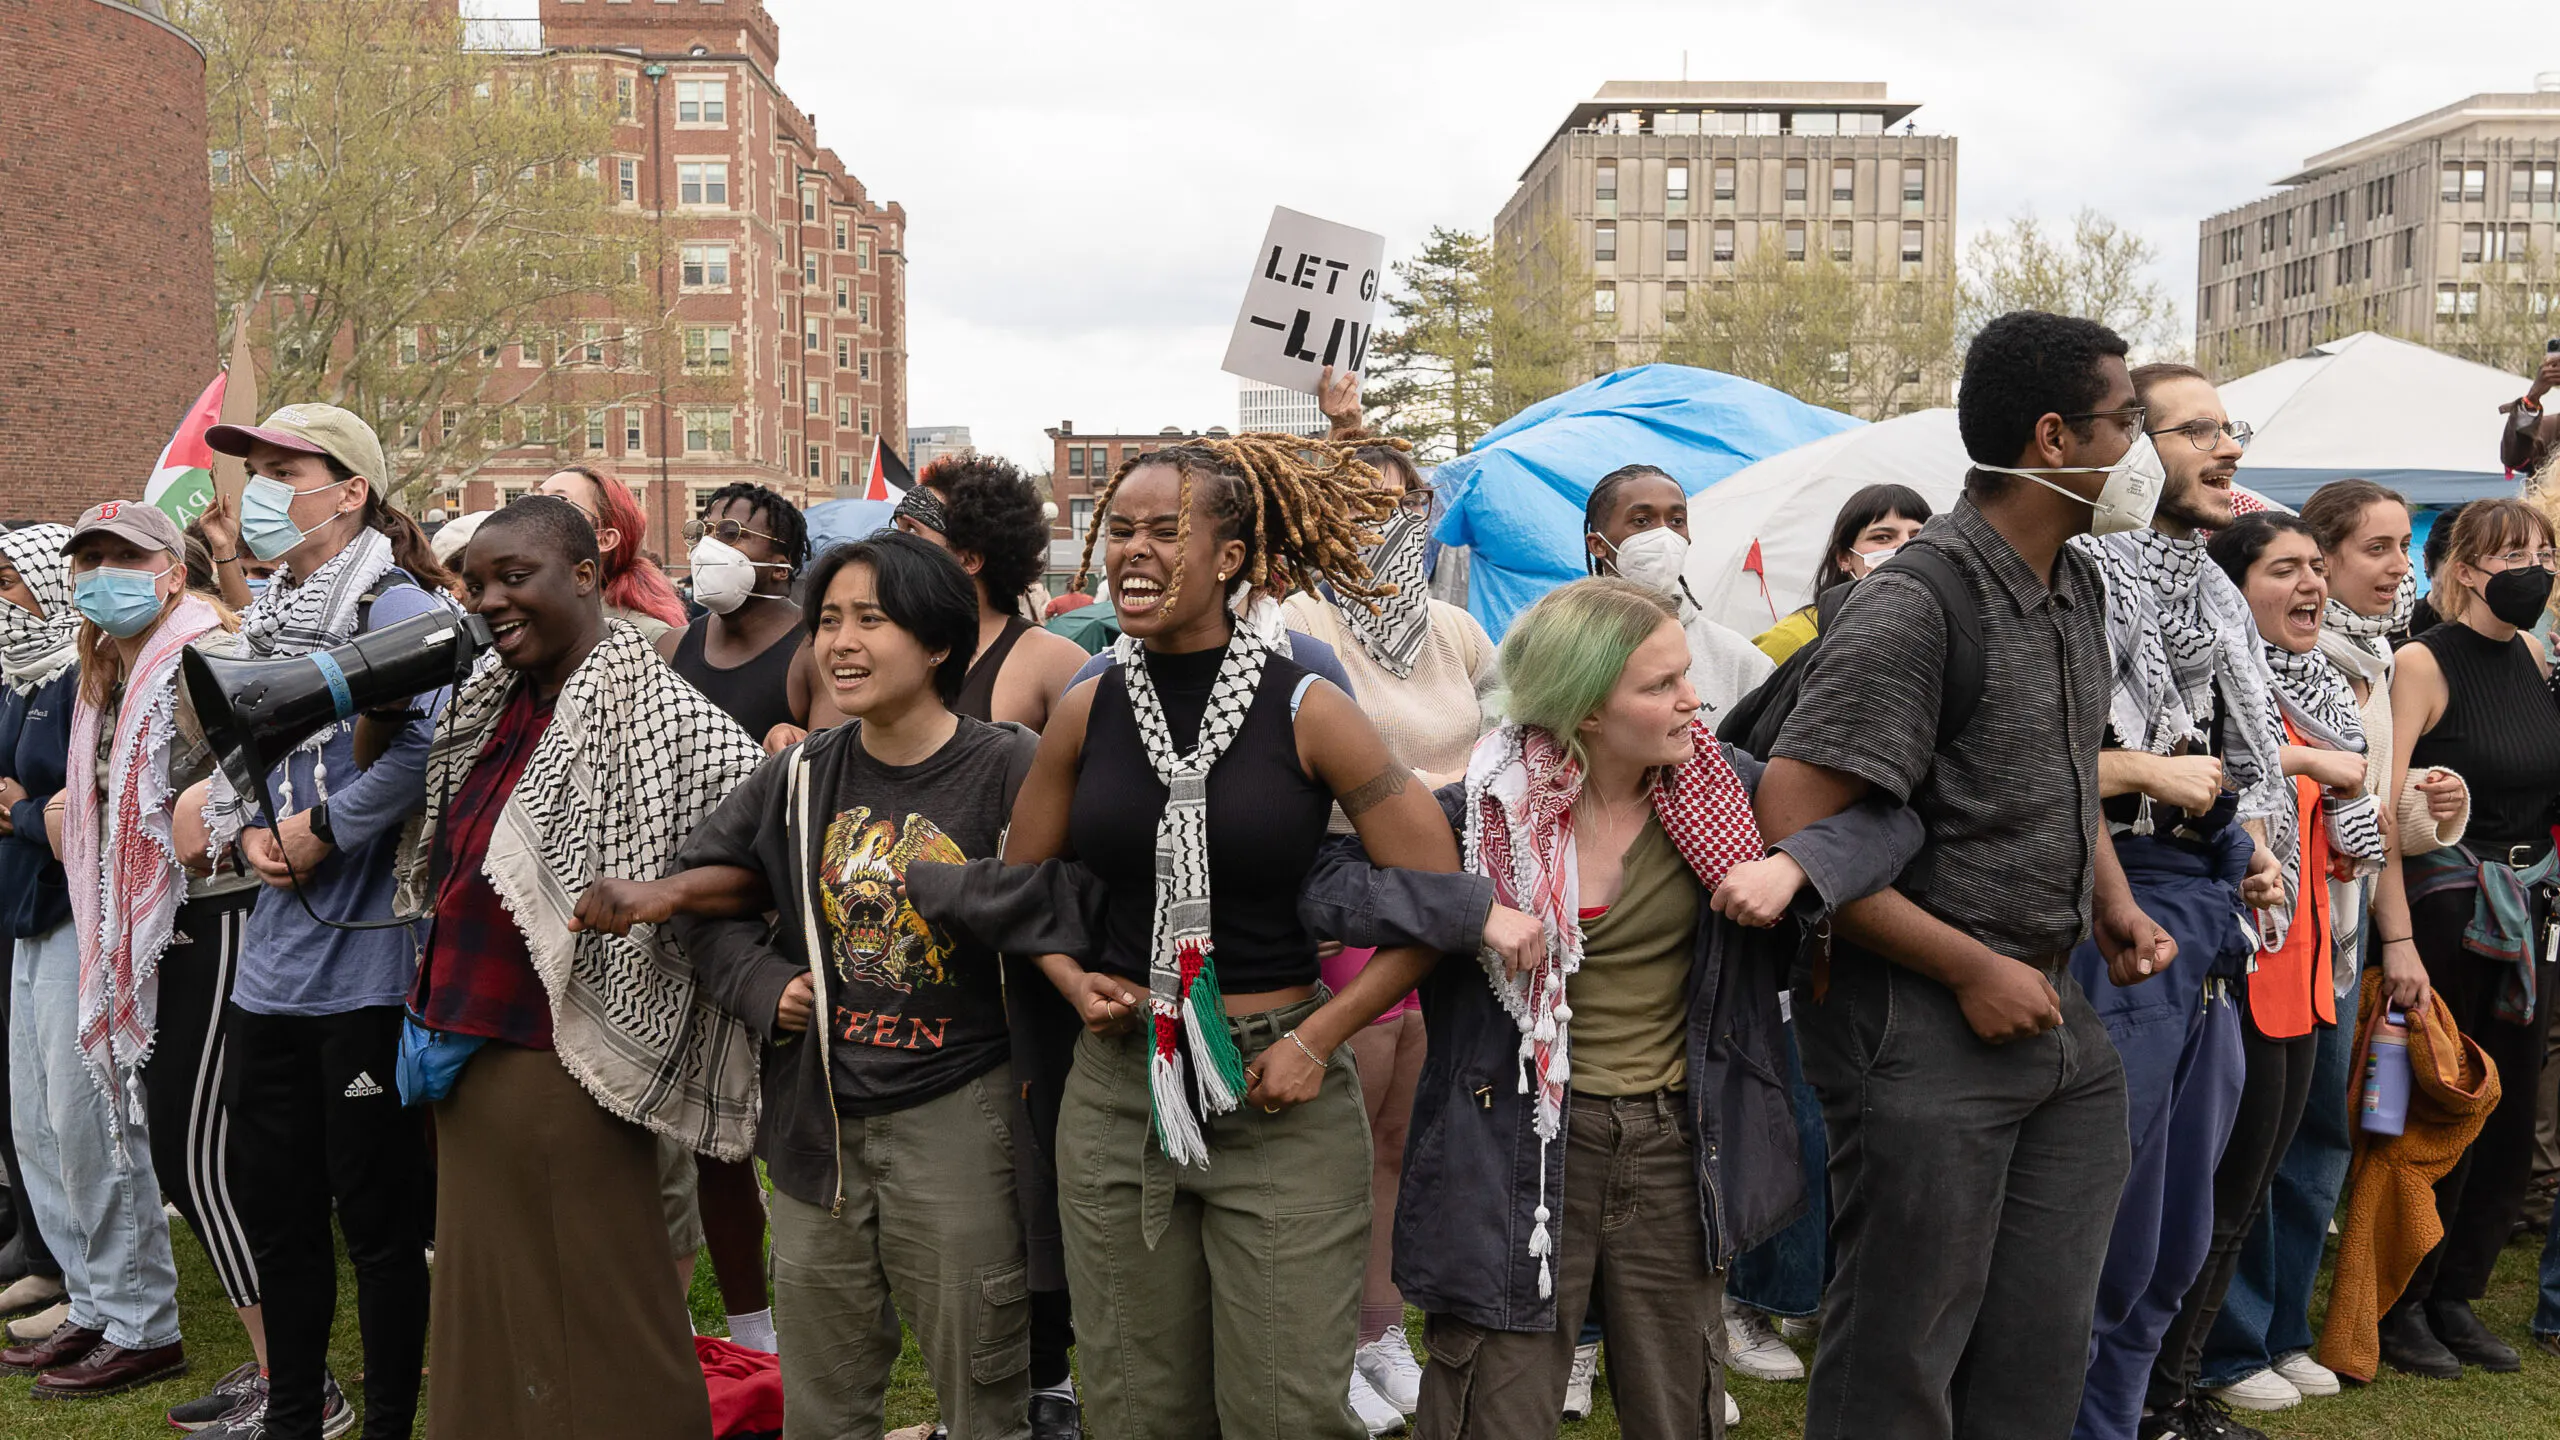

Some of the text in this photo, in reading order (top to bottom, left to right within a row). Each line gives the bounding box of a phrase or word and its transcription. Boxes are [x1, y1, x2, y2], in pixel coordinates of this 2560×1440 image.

[1265, 245, 1349, 295] LET
[96, 502, 121, 521] B
[835, 1005, 952, 1049] EEN
[344, 1085, 384, 1098] adidas
